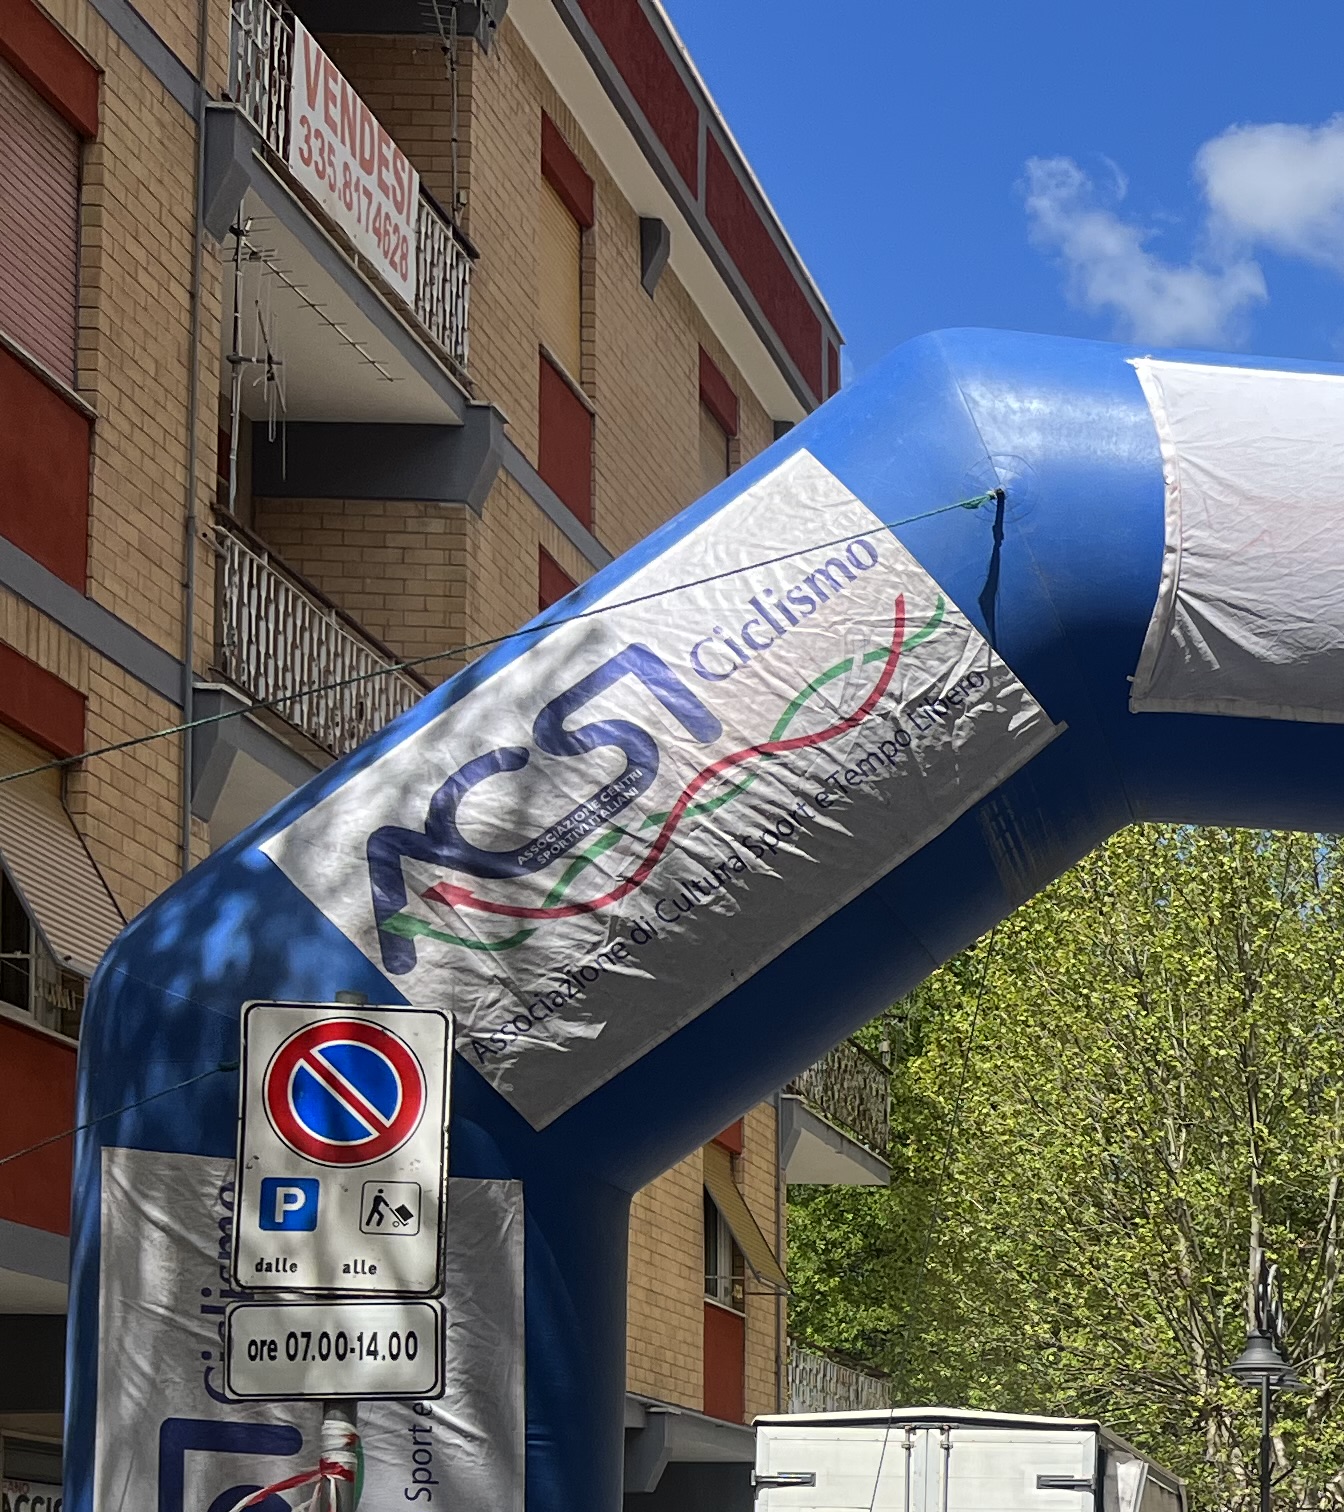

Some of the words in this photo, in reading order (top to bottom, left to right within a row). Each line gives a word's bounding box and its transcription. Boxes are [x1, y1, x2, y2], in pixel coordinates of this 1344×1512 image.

[302, 35, 413, 226] VENDESI
[298, 115, 409, 283] 335.8174628
[688, 538, 879, 682] Ciclismo
[517, 800, 601, 865] ASSOCIAZIONE
[600, 769, 643, 802] CENTRI
[536, 823, 590, 864] SPORTIVI
[587, 786, 639, 828] ITALIANI
[471, 935, 631, 1064] Associazione
[629, 911, 660, 945] di
[655, 850, 749, 926] Cultura
[746, 794, 818, 870] Sport
[822, 726, 914, 803] Tempo
[909, 666, 986, 735] Libero
[275, 1187, 306, 1223] P
[255, 1258, 298, 1273] dalle
[342, 1259, 378, 1275] alle
[247, 1339, 278, 1361] ore
[285, 1331, 418, 1361] 07.00-14.00
[417, 1401, 434, 1418] e
[405, 1423, 441, 1503] Sport
